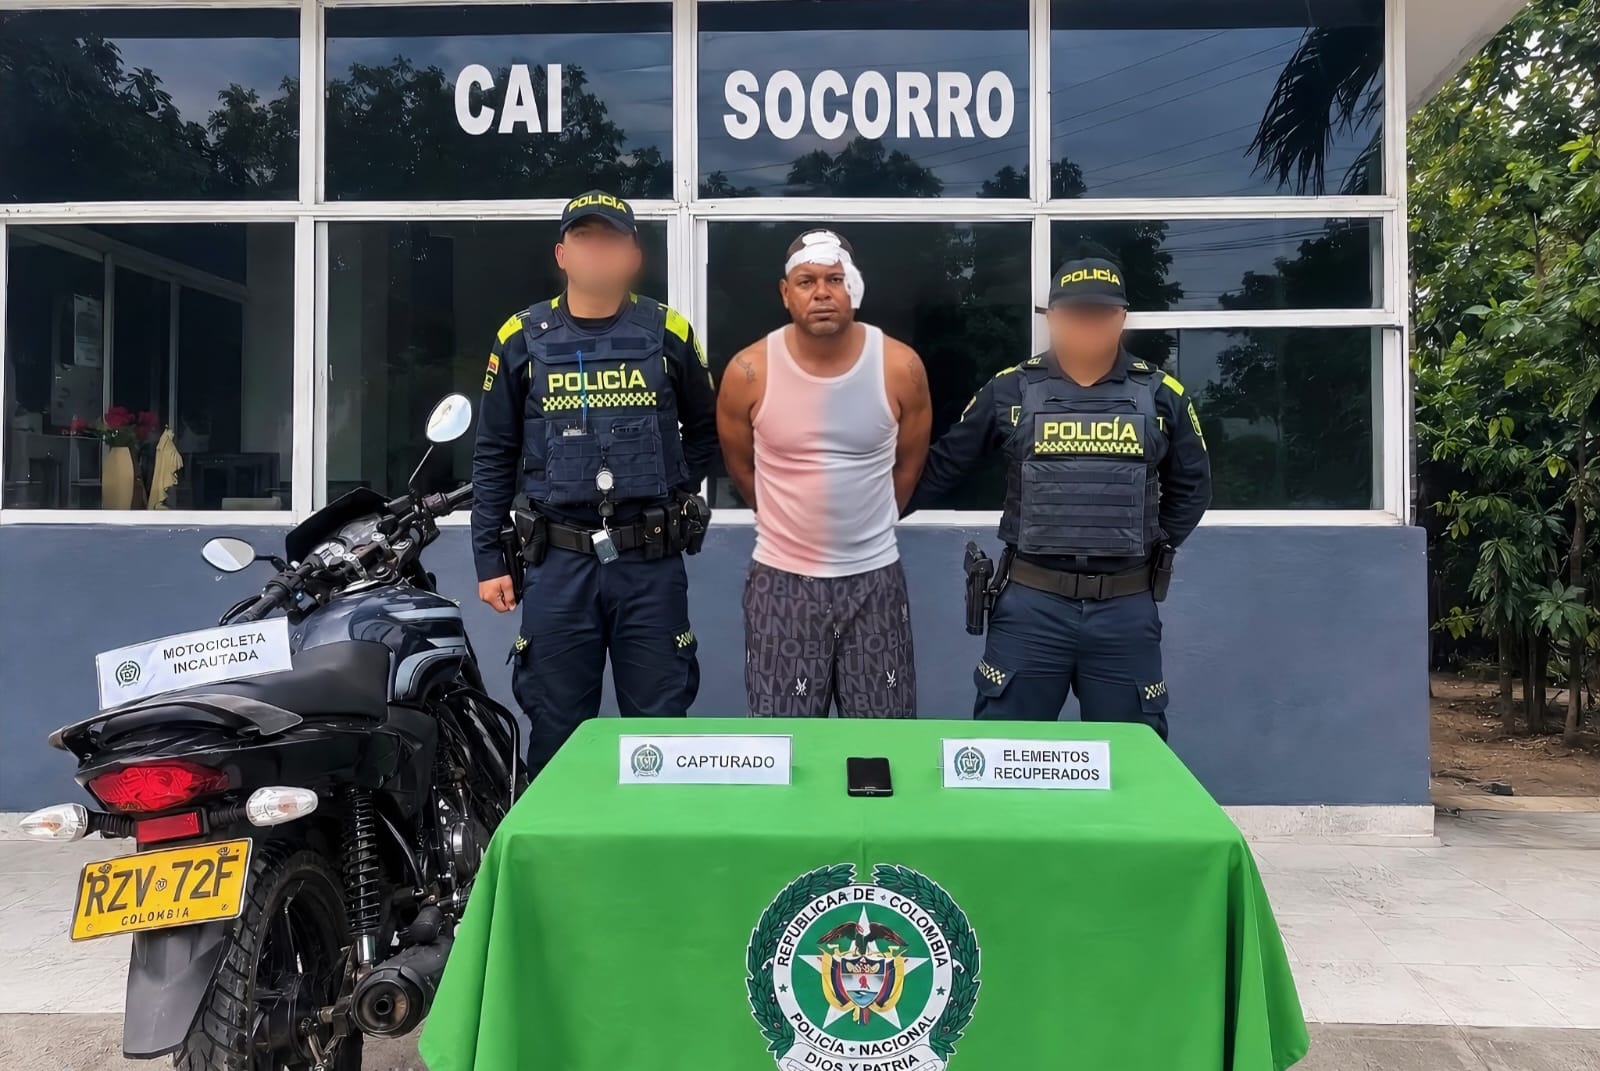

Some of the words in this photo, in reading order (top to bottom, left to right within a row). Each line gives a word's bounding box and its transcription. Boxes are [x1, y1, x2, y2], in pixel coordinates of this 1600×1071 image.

[454, 63, 564, 136] CAI
[723, 69, 1015, 140] SOCORRO
[1060, 268, 1121, 288] POLICÍA
[547, 362, 647, 393] POLICÍA
[1043, 415, 1138, 442] POLICÍA
[163, 632, 266, 661] MOTOCICLETA
[173, 649, 259, 675] INCAUTADA
[676, 755, 775, 769] CAPTURADO
[1003, 749, 1090, 763] ELEMENTOS
[994, 767, 1100, 781] RECUPERADOS
[84, 866, 156, 917] RZV
[172, 855, 239, 903] 72F
[121, 907, 189, 926] COLOMBIA
[853, 888, 875, 901] DE
[889, 896, 949, 968] COLOMBIA
[790, 1012, 846, 1055] POLICÍA
[859, 1014, 936, 1056] NACIONAL
[804, 1051, 843, 1071] DIOS
[863, 1054, 920, 1071] PATRIA
